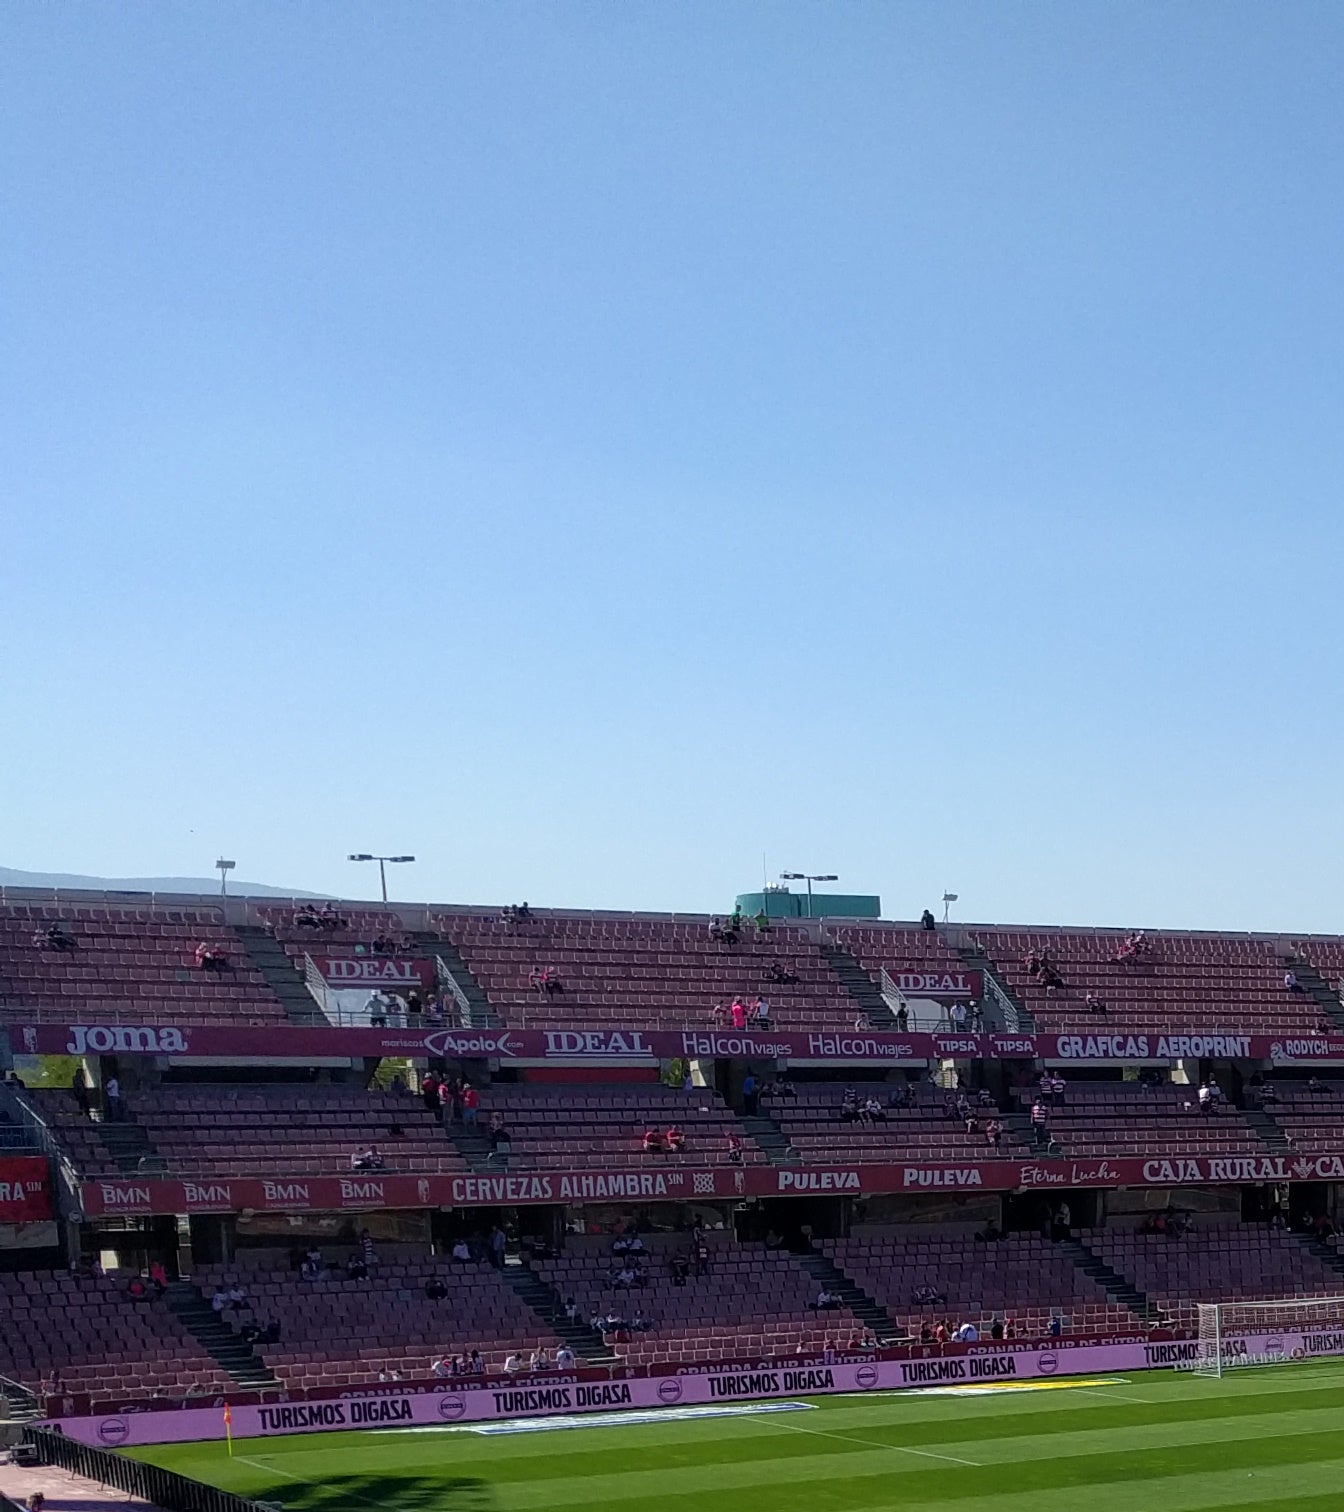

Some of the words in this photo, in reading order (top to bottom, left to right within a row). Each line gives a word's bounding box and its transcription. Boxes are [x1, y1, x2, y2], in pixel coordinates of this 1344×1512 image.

[325, 961, 420, 979] IDEAL
[897, 973, 971, 990] IDEAL
[443, 1036, 496, 1054] Apolo
[543, 1031, 652, 1054] IDEAL
[682, 1032, 754, 1055] Halcon
[755, 1043, 792, 1058] viajes
[808, 1033, 877, 1056] Halcon
[878, 1043, 913, 1058] viajes
[938, 1040, 977, 1051] TIPSA
[994, 1040, 1033, 1052] TIPSA
[1057, 1036, 1149, 1058] GRAFICAS
[1156, 1036, 1251, 1058] AEROPRINT
[1286, 1039, 1328, 1056] RODYCH
[904, 1168, 982, 1187] PULEVA
[1020, 1166, 1067, 1184] Eterna
[1072, 1163, 1120, 1181] Lucha
[1143, 1158, 1202, 1182] CAJA
[1209, 1157, 1291, 1180] RURAL
[27, 1182, 42, 1192] SIN
[452, 1177, 553, 1201] CERVEZAS
[560, 1173, 667, 1199] ALHAMBRA
[668, 1173, 684, 1186] SIN
[778, 1171, 861, 1190] PULEVA
[103, 1187, 151, 1204] BMN
[184, 1185, 231, 1202] BMN
[266, 1184, 309, 1200] BMN
[342, 1183, 384, 1198] BMN
[900, 1361, 965, 1384] TURISMOS
[969, 1357, 1016, 1377] DIGASA
[708, 1372, 778, 1397] TURISMOS
[783, 1368, 835, 1390] DIGASA
[493, 1388, 571, 1414] TURISMOS
[576, 1383, 633, 1406] DIGASA
[258, 1403, 345, 1431] TURISMOS
[350, 1399, 413, 1424] DIGASA
